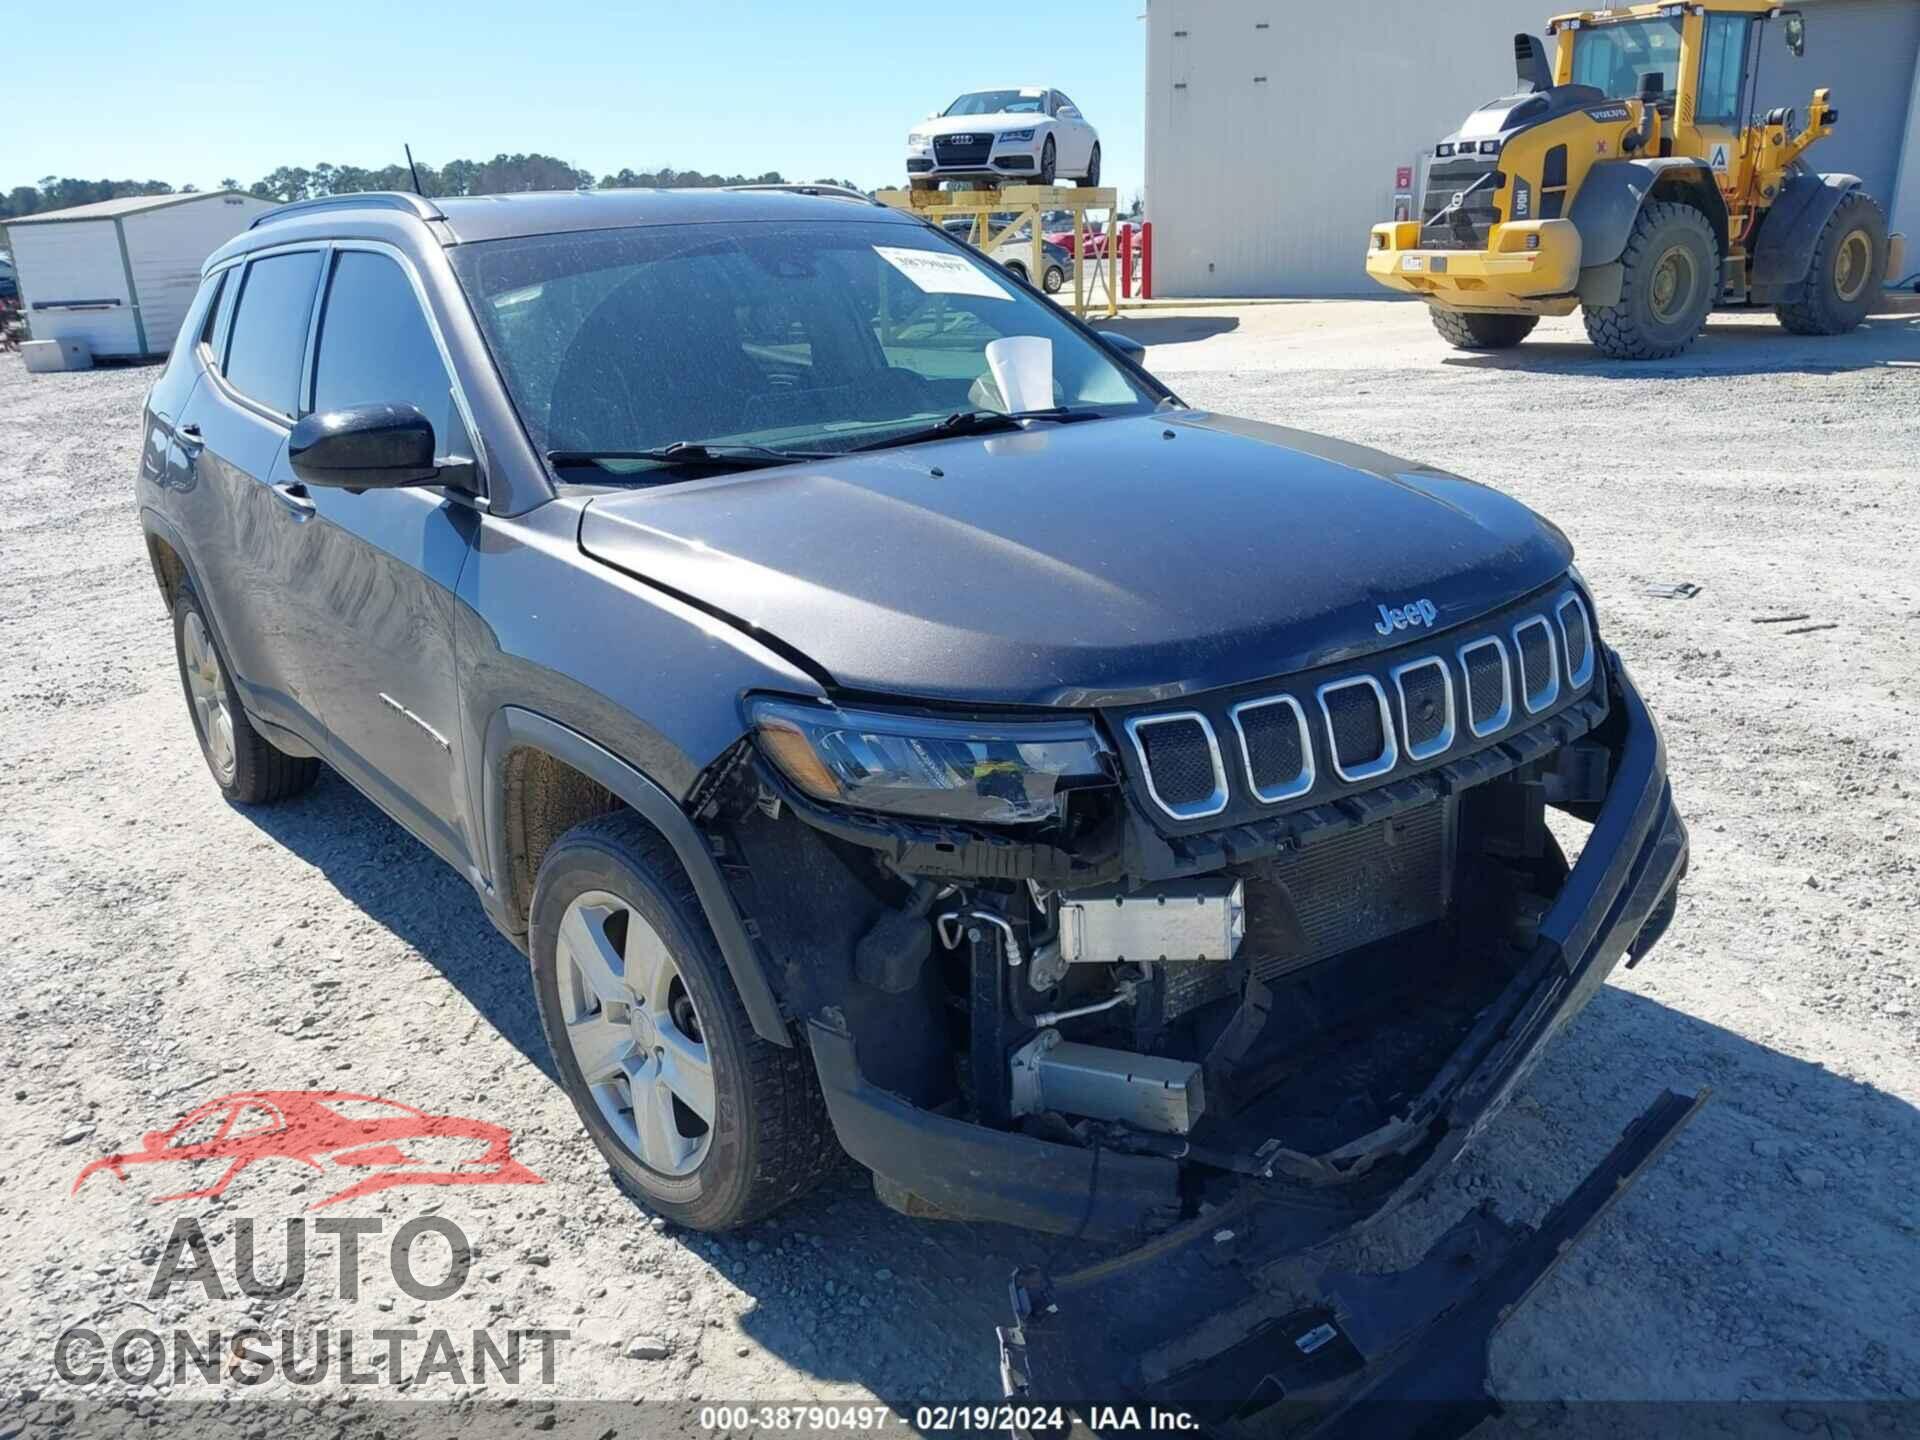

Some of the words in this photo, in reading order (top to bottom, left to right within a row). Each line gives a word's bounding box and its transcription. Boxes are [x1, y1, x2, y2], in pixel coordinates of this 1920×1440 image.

[1591, 109, 1627, 119] VOLVO
[1516, 190, 1528, 215] L90H
[1375, 598, 1436, 635] Jeep
